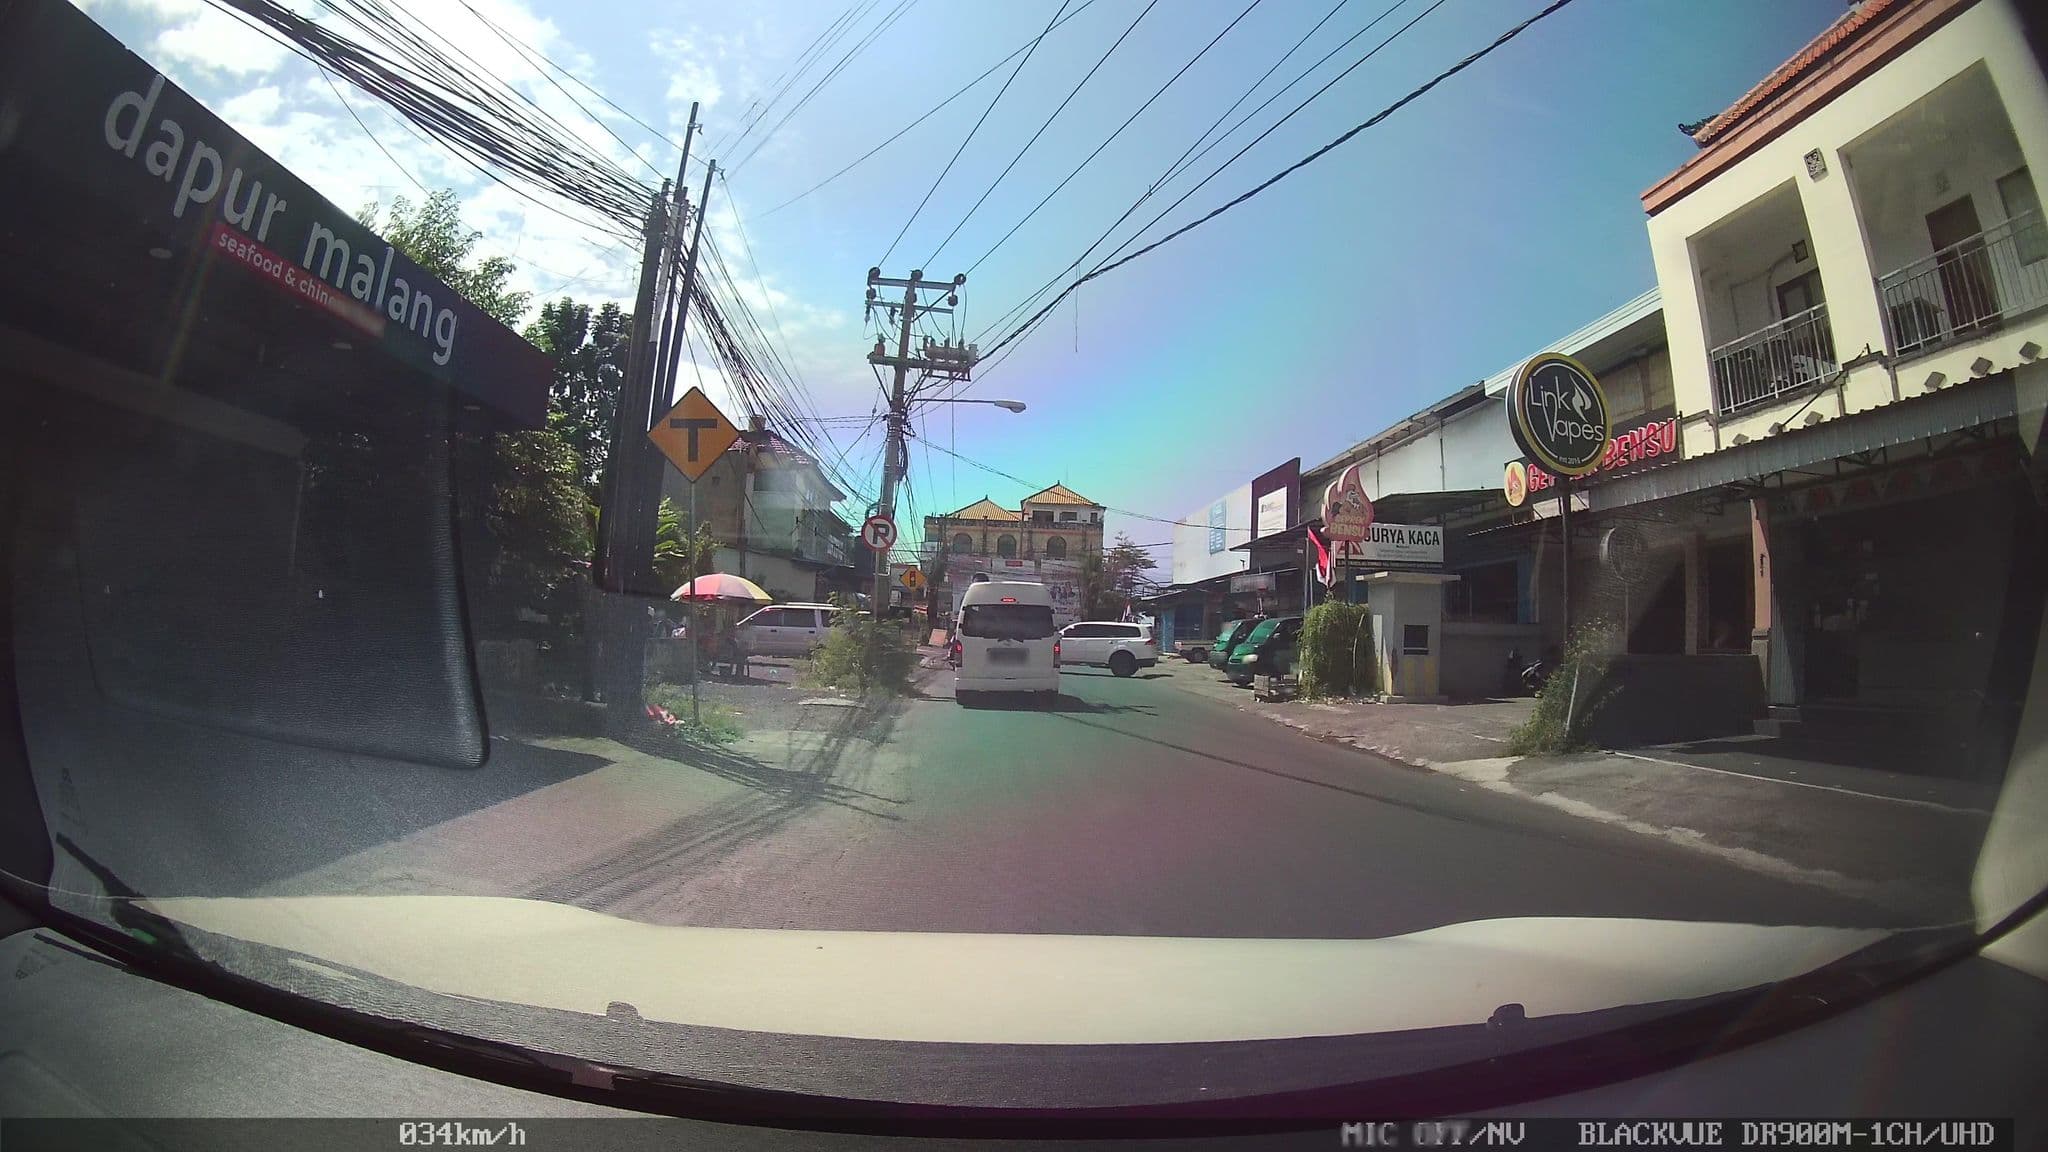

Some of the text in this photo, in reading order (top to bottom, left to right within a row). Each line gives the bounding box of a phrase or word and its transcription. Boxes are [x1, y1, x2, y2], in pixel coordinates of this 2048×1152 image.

[104, 74, 458, 366] dapur malang
[218, 232, 284, 279] seafood
[284, 267, 296, 287] &
[1529, 375, 1571, 411] Link
[1543, 405, 1604, 445] Vapes
[1602, 417, 1677, 471] BENSU
[872, 523, 890, 545] P
[1408, 529, 1440, 546] KACA
